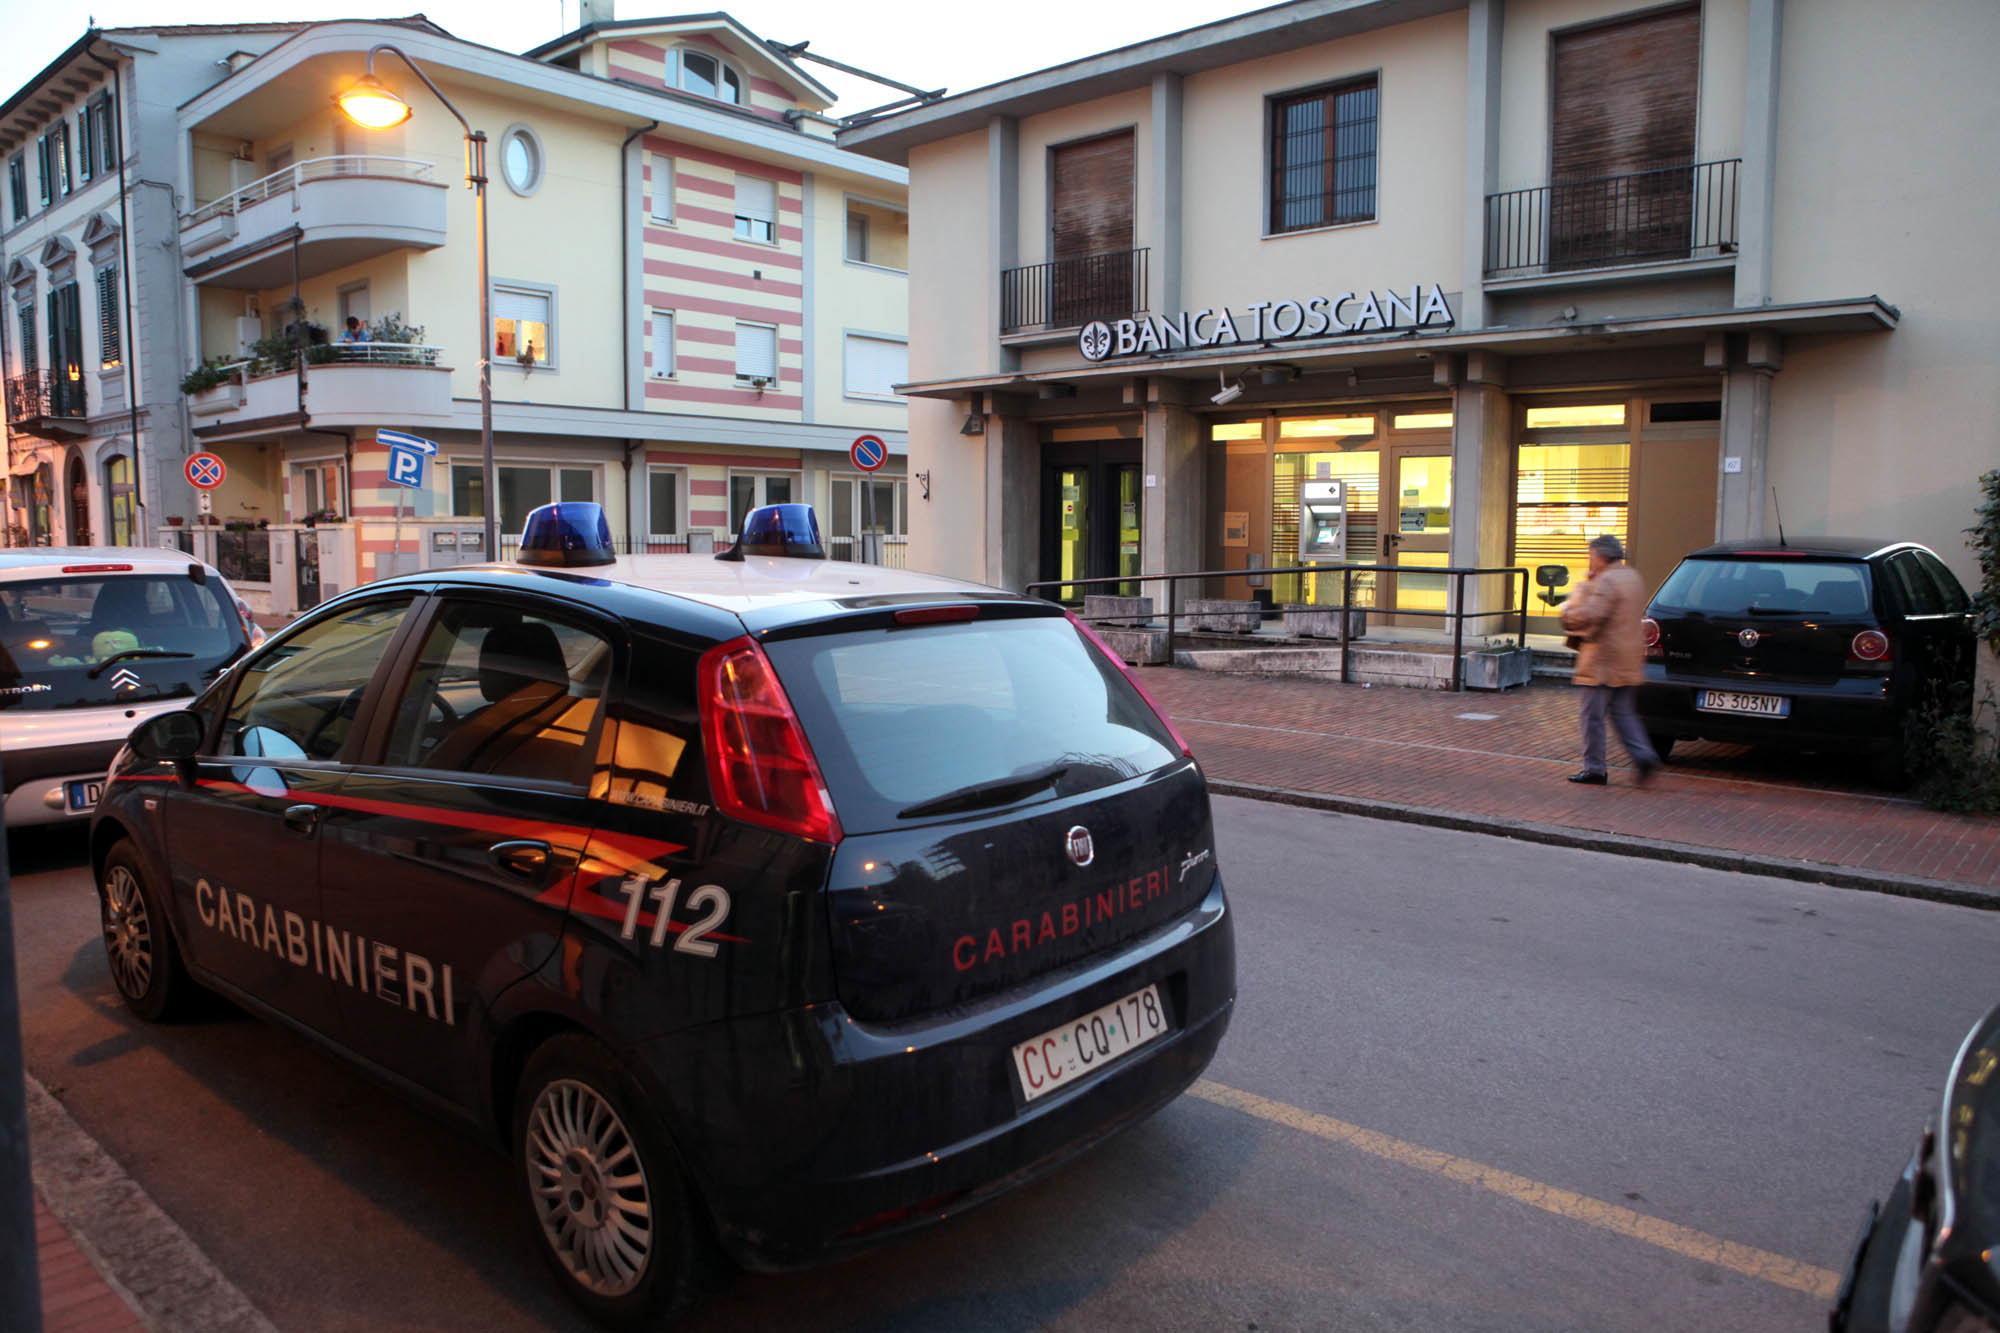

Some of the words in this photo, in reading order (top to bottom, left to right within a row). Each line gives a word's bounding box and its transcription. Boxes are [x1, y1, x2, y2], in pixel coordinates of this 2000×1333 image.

[1117, 307, 1240, 355] BANCA
[1248, 283, 1455, 342] TOSCANA
[395, 451, 417, 480] P
[1707, 692, 1725, 707] DS
[1731, 694, 1779, 712] 303NV
[196, 878, 455, 1026] CARABINIERI
[620, 873, 731, 958] 112
[953, 865, 1169, 972] CARABINIERI
[1023, 1038, 1062, 1089] CC
[1075, 1016, 1110, 1064] CQ
[1116, 991, 1160, 1042] 178
